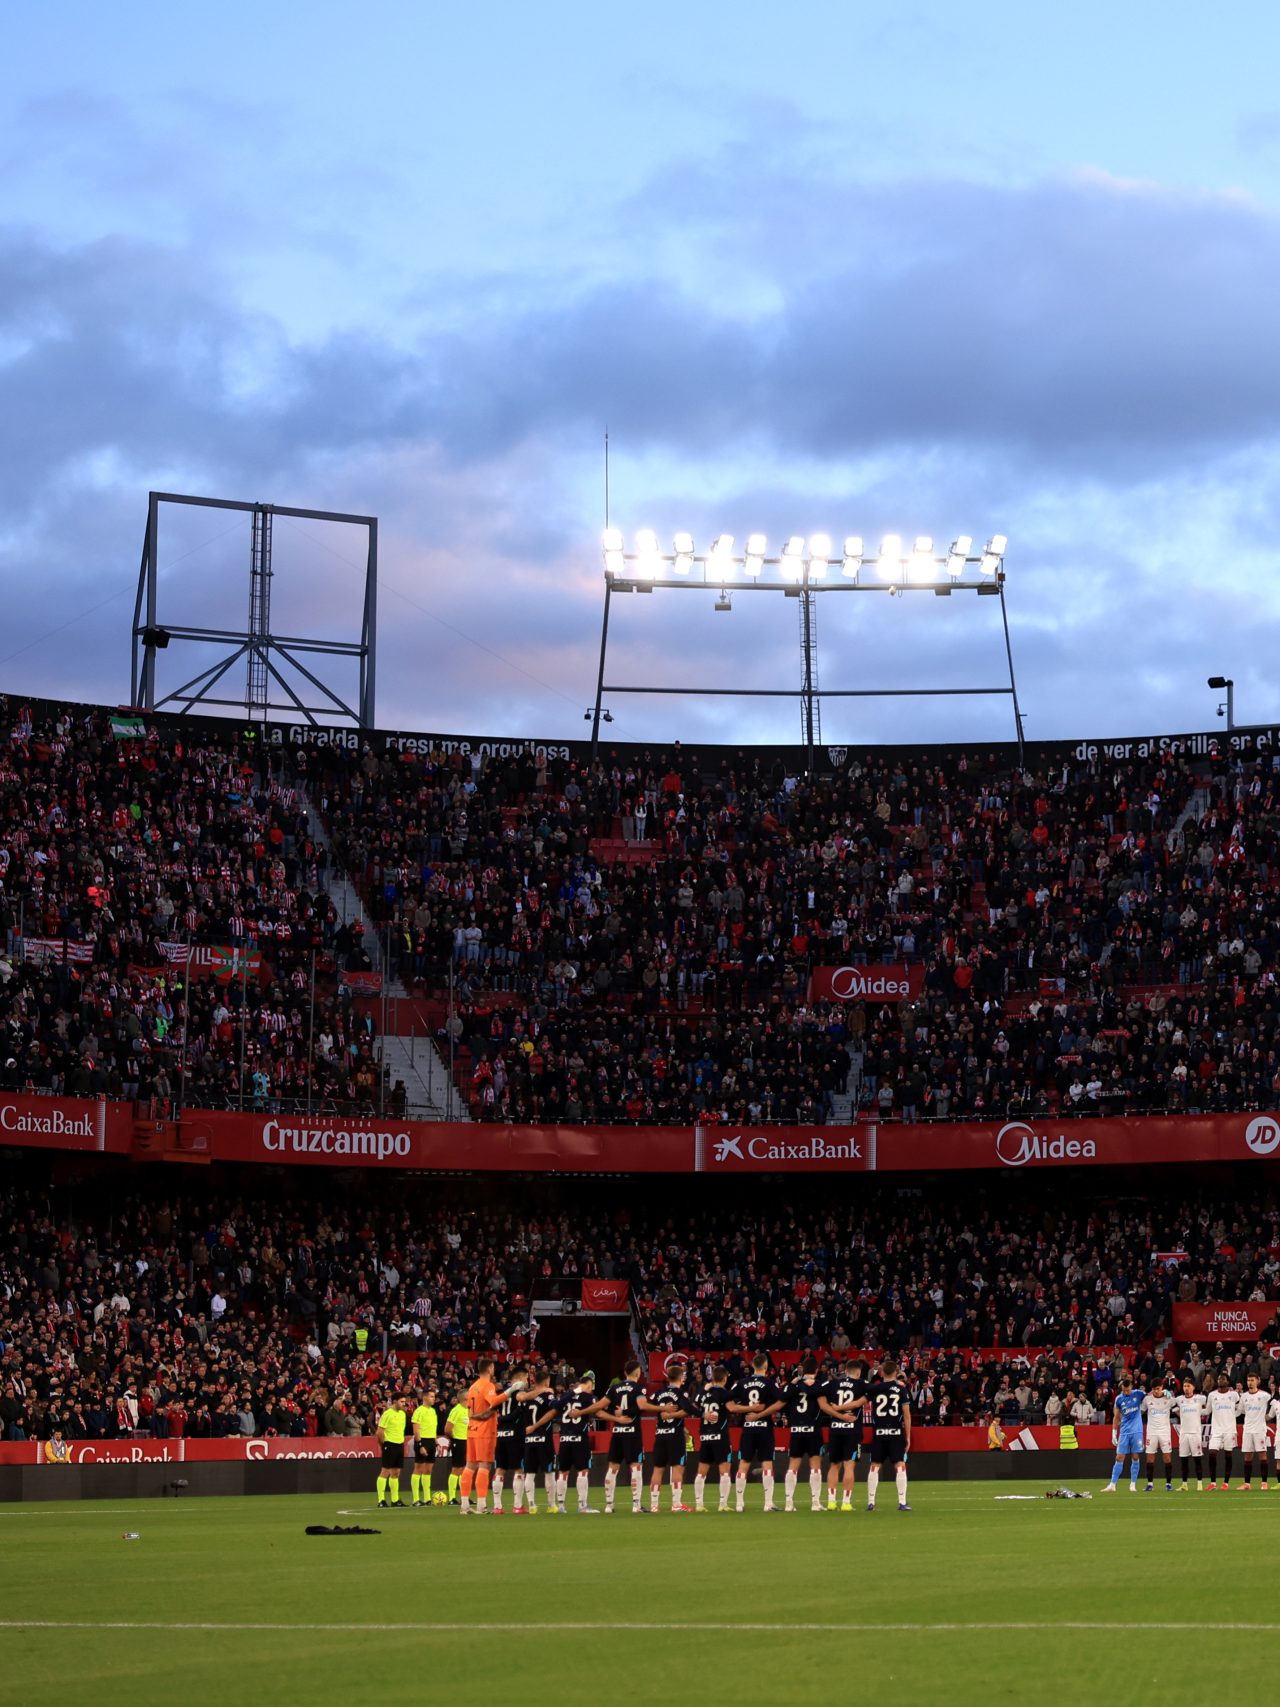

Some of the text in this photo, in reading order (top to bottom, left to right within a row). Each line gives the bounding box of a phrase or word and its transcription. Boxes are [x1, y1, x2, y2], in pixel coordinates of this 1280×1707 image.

[290, 726, 359, 749] Giralda
[480, 741, 570, 760] orgulosa
[1075, 742, 1098, 761] de
[1103, 744, 1133, 759] ver
[1138, 739, 1154, 758] al
[0, 1105, 94, 1136] CaixaBank
[263, 1119, 411, 1160] Cruzcampo
[748, 1137, 862, 1159] CaixaBank
[1000, 1128, 1096, 1163] Midea
[1206, 1321, 1256, 1332] TE RINDAS
[1214, 1311, 1248, 1321] NUNCA
[796, 1392, 808, 1414] 3
[876, 1394, 900, 1417] 23
